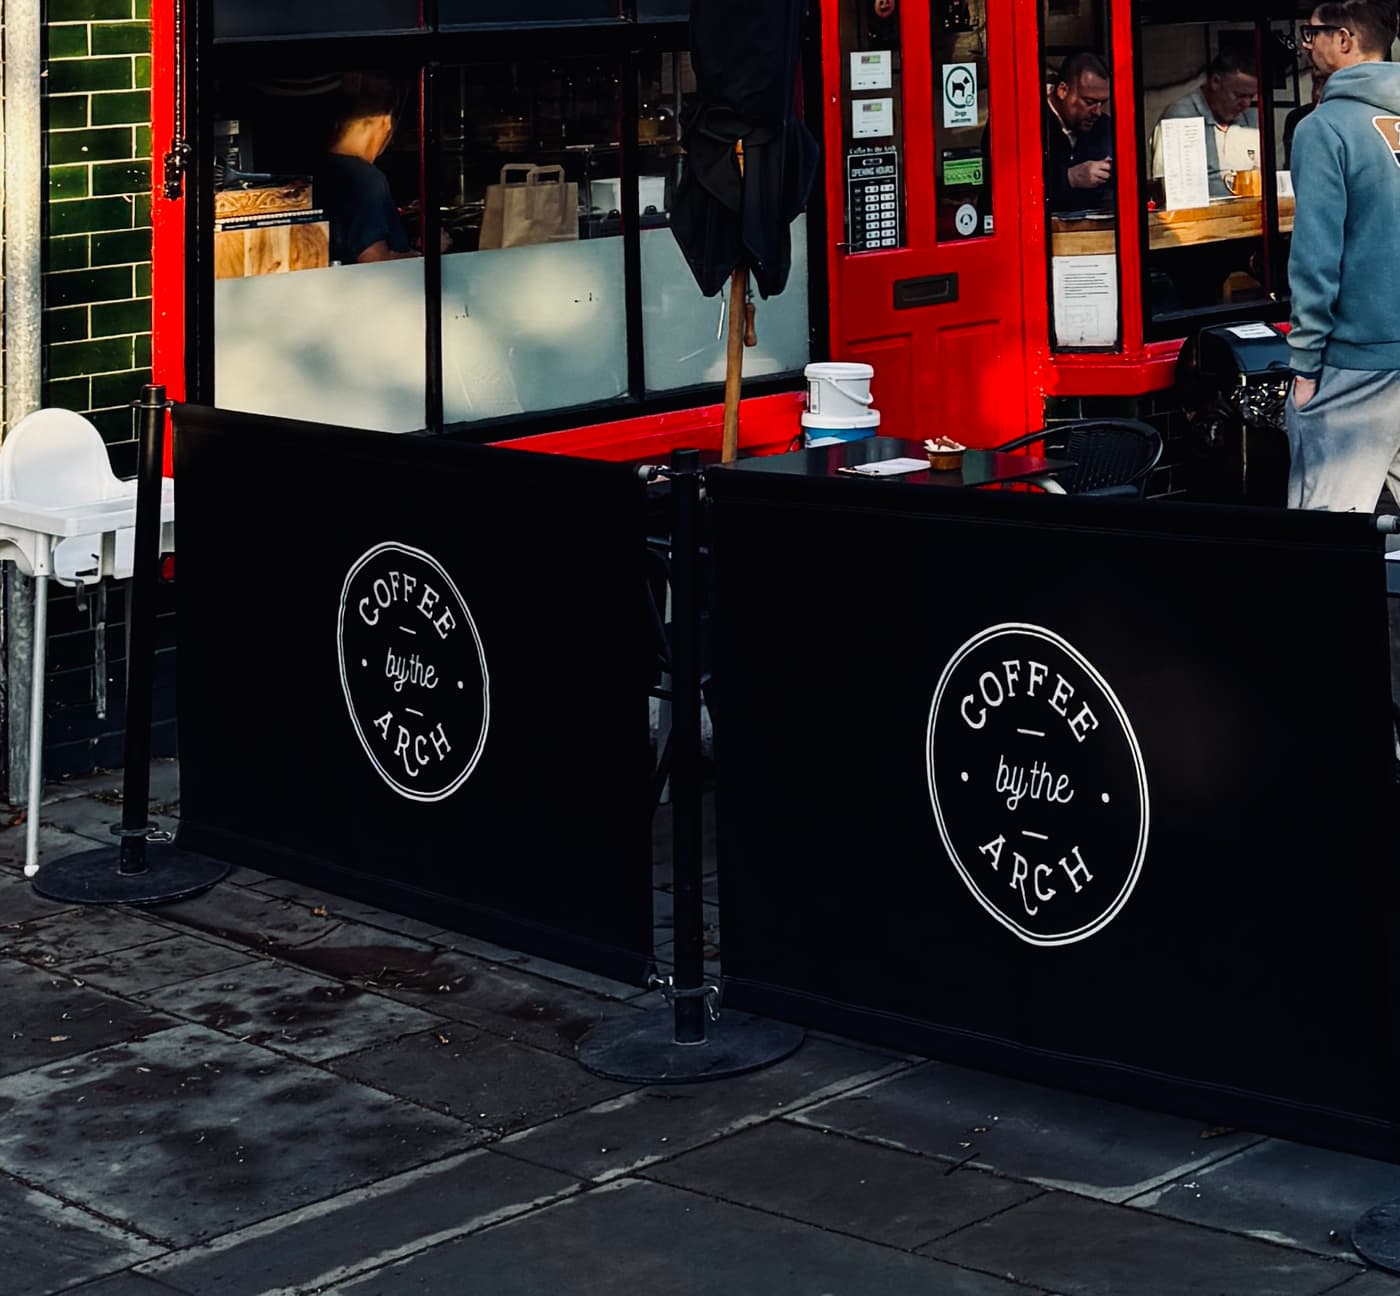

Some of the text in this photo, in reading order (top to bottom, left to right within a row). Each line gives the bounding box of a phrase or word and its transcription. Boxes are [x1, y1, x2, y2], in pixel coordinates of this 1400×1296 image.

[359, 571, 456, 639] COFFEE
[385, 647, 439, 692] by the
[960, 659, 1099, 743] COFFEE
[373, 711, 452, 777] ARCH
[995, 754, 1074, 811] by the
[978, 834, 1094, 916] ARCH
